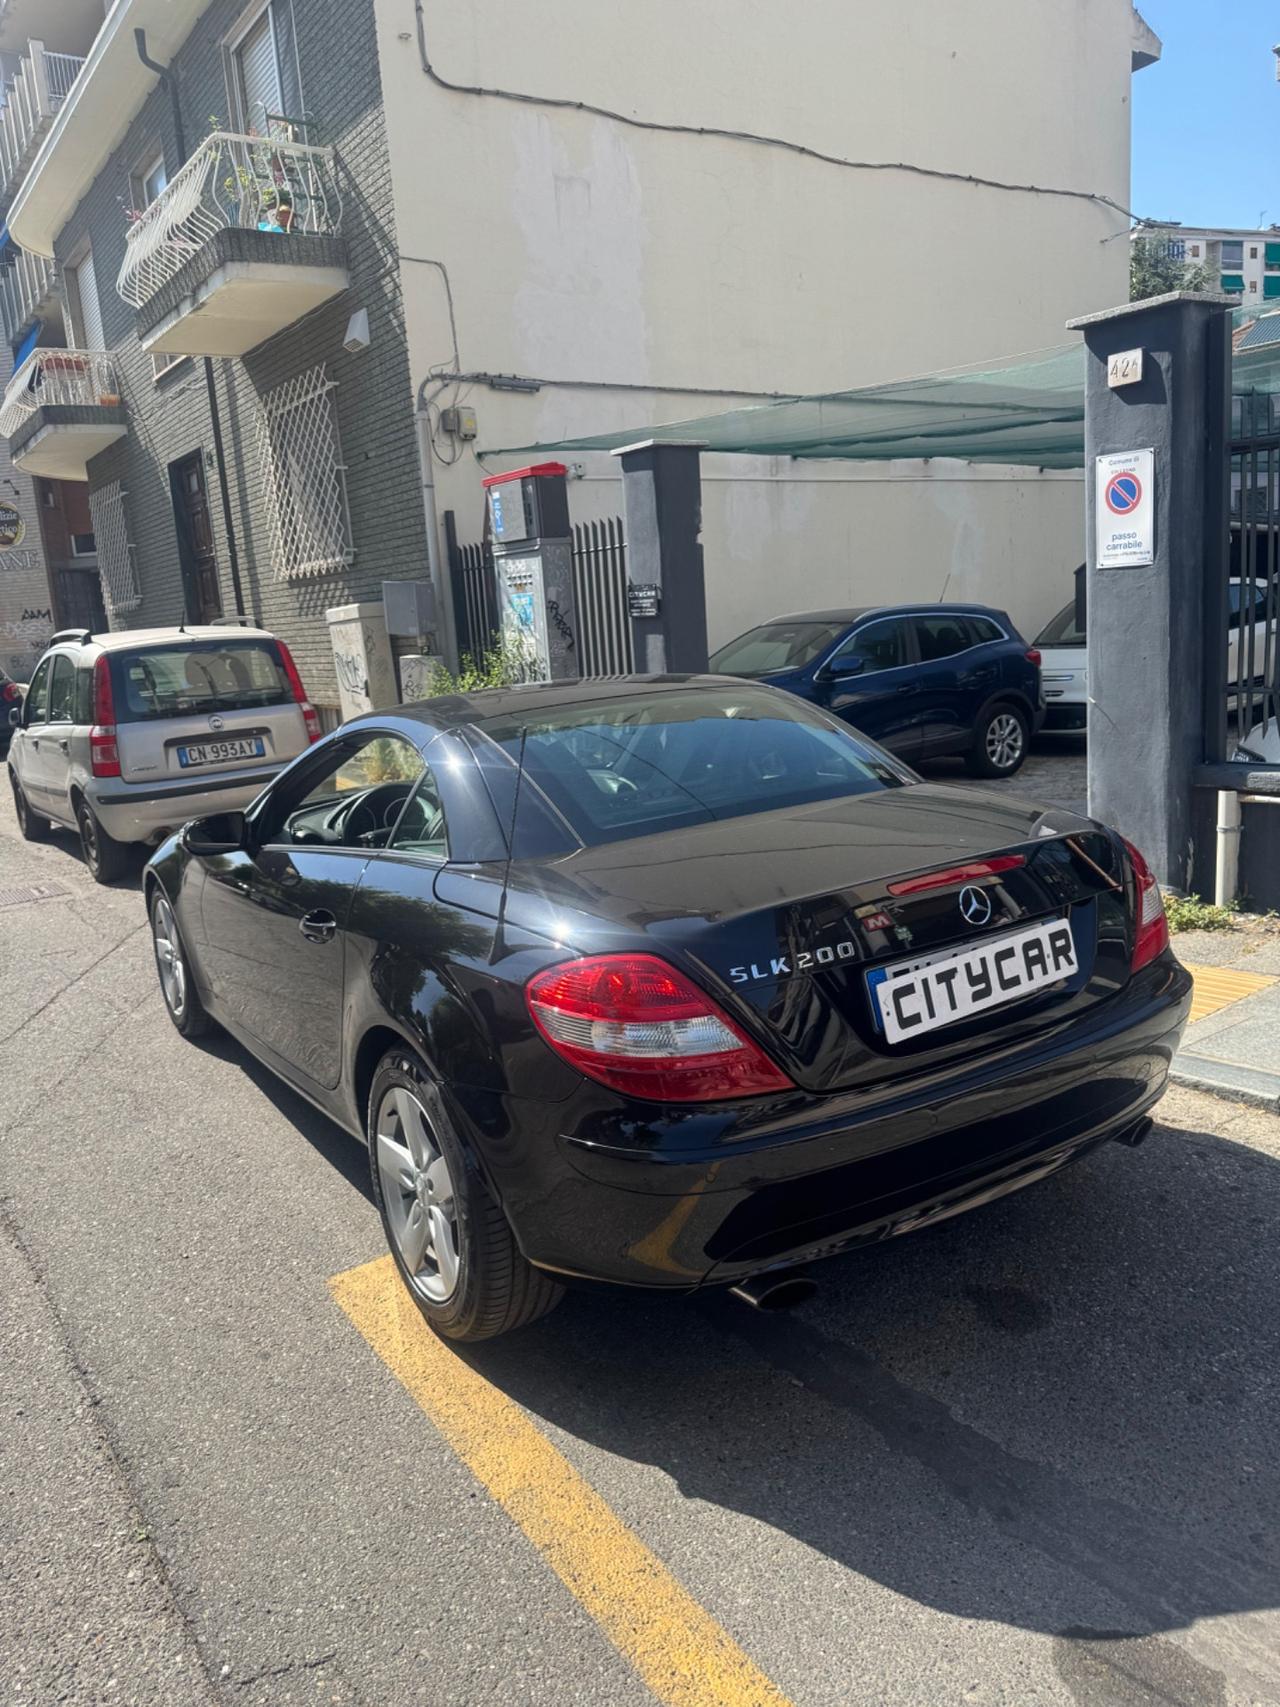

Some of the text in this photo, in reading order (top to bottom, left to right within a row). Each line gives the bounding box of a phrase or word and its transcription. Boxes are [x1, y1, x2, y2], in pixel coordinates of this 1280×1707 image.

[1106, 541, 1143, 551] carrabile
[1112, 532, 1137, 542] passo
[188, 746, 208, 762] CN
[211, 741, 255, 759] 993AY
[729, 941, 855, 983] SLK 200
[892, 927, 1075, 1030] CITYCAR
